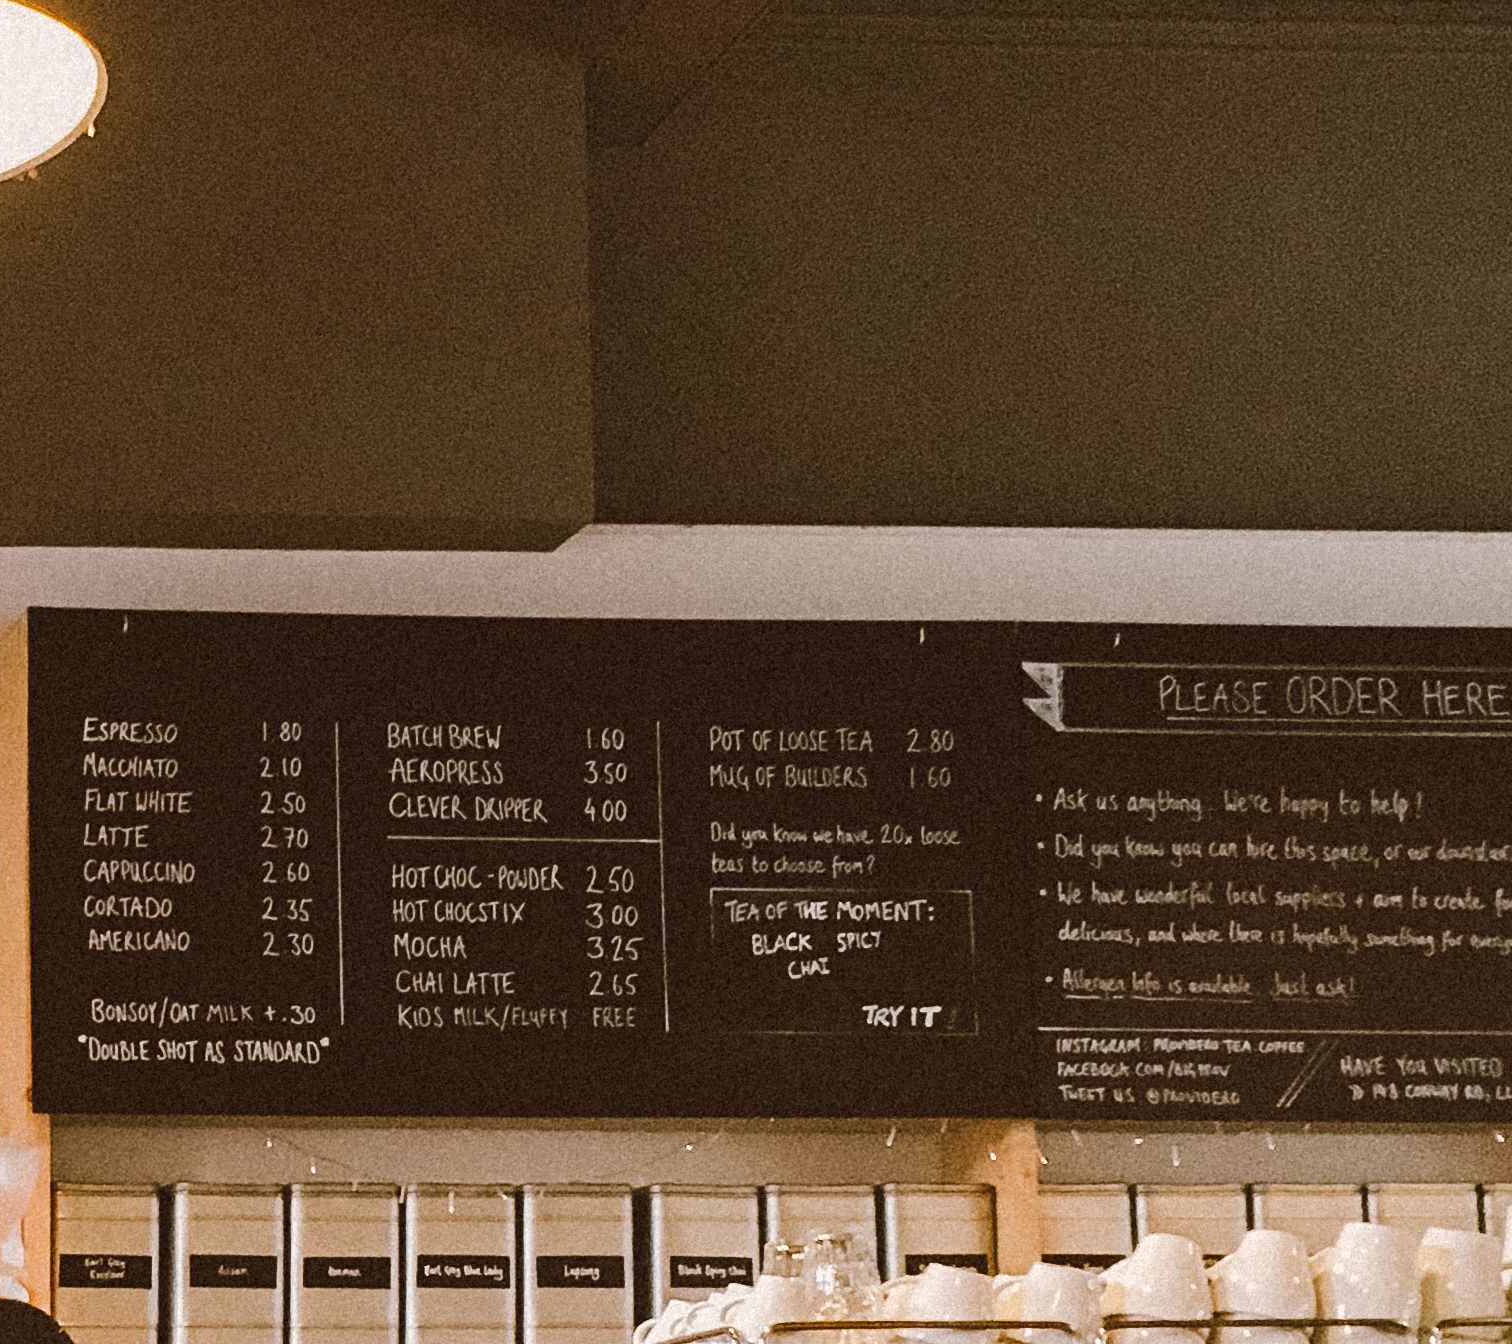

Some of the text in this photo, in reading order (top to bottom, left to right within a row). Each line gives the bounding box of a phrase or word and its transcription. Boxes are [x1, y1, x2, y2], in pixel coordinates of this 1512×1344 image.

[1158, 674, 1510, 717] PLEASE ORDER HERE
[83, 717, 178, 743] ESPRESSO
[387, 722, 443, 749] BATCH
[447, 723, 502, 749] BREW
[709, 725, 745, 752] POT
[752, 729, 773, 752] OF
[779, 729, 829, 752] LOOSE
[835, 726, 874, 753] TEA
[83, 752, 178, 778] MACCHIATO
[388, 757, 504, 785] AEROPRESS
[709, 764, 750, 792] MUG
[755, 765, 777, 788] OF
[785, 763, 868, 789] BUILDERS
[85, 788, 128, 812] FLAT
[135, 791, 193, 814] WHITE
[388, 791, 467, 820] CLEVER
[475, 796, 548, 823] DRIPPER
[1053, 787, 1088, 812] Ask
[1096, 794, 1119, 811] us
[1279, 786, 1330, 824] happy
[1339, 788, 1361, 815] to
[83, 823, 149, 848] LATTE
[710, 821, 736, 843] Did
[741, 829, 769, 849] you
[773, 821, 807, 843] know
[812, 829, 833, 844] we
[836, 824, 874, 845] have
[921, 825, 961, 846] loose
[1055, 833, 1085, 859] Did
[1090, 842, 1120, 870] you
[1125, 835, 1164, 859] know
[1170, 842, 1203, 868] you
[1207, 841, 1238, 859] can
[1246, 834, 1278, 860] hire
[1284, 836, 1317, 862] this
[1383, 844, 1402, 860] or
[83, 859, 196, 884] CAPPUCCINO
[391, 864, 430, 889] HOT
[711, 852, 875, 879] teas to choose from?
[83, 895, 173, 919] CORTADO
[1058, 881, 1082, 906] We
[1091, 881, 1128, 905] have
[1135, 881, 1215, 910] wonderful
[1226, 881, 1267, 906] local
[1274, 884, 1345, 914] suppliers
[1412, 886, 1428, 909] to
[1433, 886, 1485, 911] create
[391, 899, 429, 923] HOT
[725, 899, 935, 923] TEA OF THE MOMENT:
[88, 928, 190, 953] AMERICANO
[393, 932, 467, 960] MOCHA
[751, 930, 882, 956] BLACK SPICY
[1148, 921, 1176, 942] and
[1182, 922, 1223, 944] where
[1229, 920, 1263, 943] there
[1270, 930, 1284, 945] is
[1363, 926, 1435, 957] something
[1440, 929, 1462, 953] for
[787, 957, 831, 980] CHAI
[395, 969, 444, 994] CHAI
[453, 971, 515, 996] LATTE
[1168, 978, 1183, 995] is
[90, 996, 199, 1028] BONSOY/OAT
[206, 1004, 253, 1024] MILK
[397, 1003, 636, 1032] KIDS MILK/FLUFFY FREE
[862, 1004, 905, 1028] TRY
[156, 1039, 198, 1063] SHOT
[204, 1040, 225, 1064] AS
[1222, 1039, 1250, 1055] TEA
[1257, 1040, 1305, 1054] COFFEE
[1340, 1054, 1503, 1078] HAVE YOU VISITED
[1058, 1084, 1106, 1102] TWEET
[1112, 1087, 1135, 1103] US
